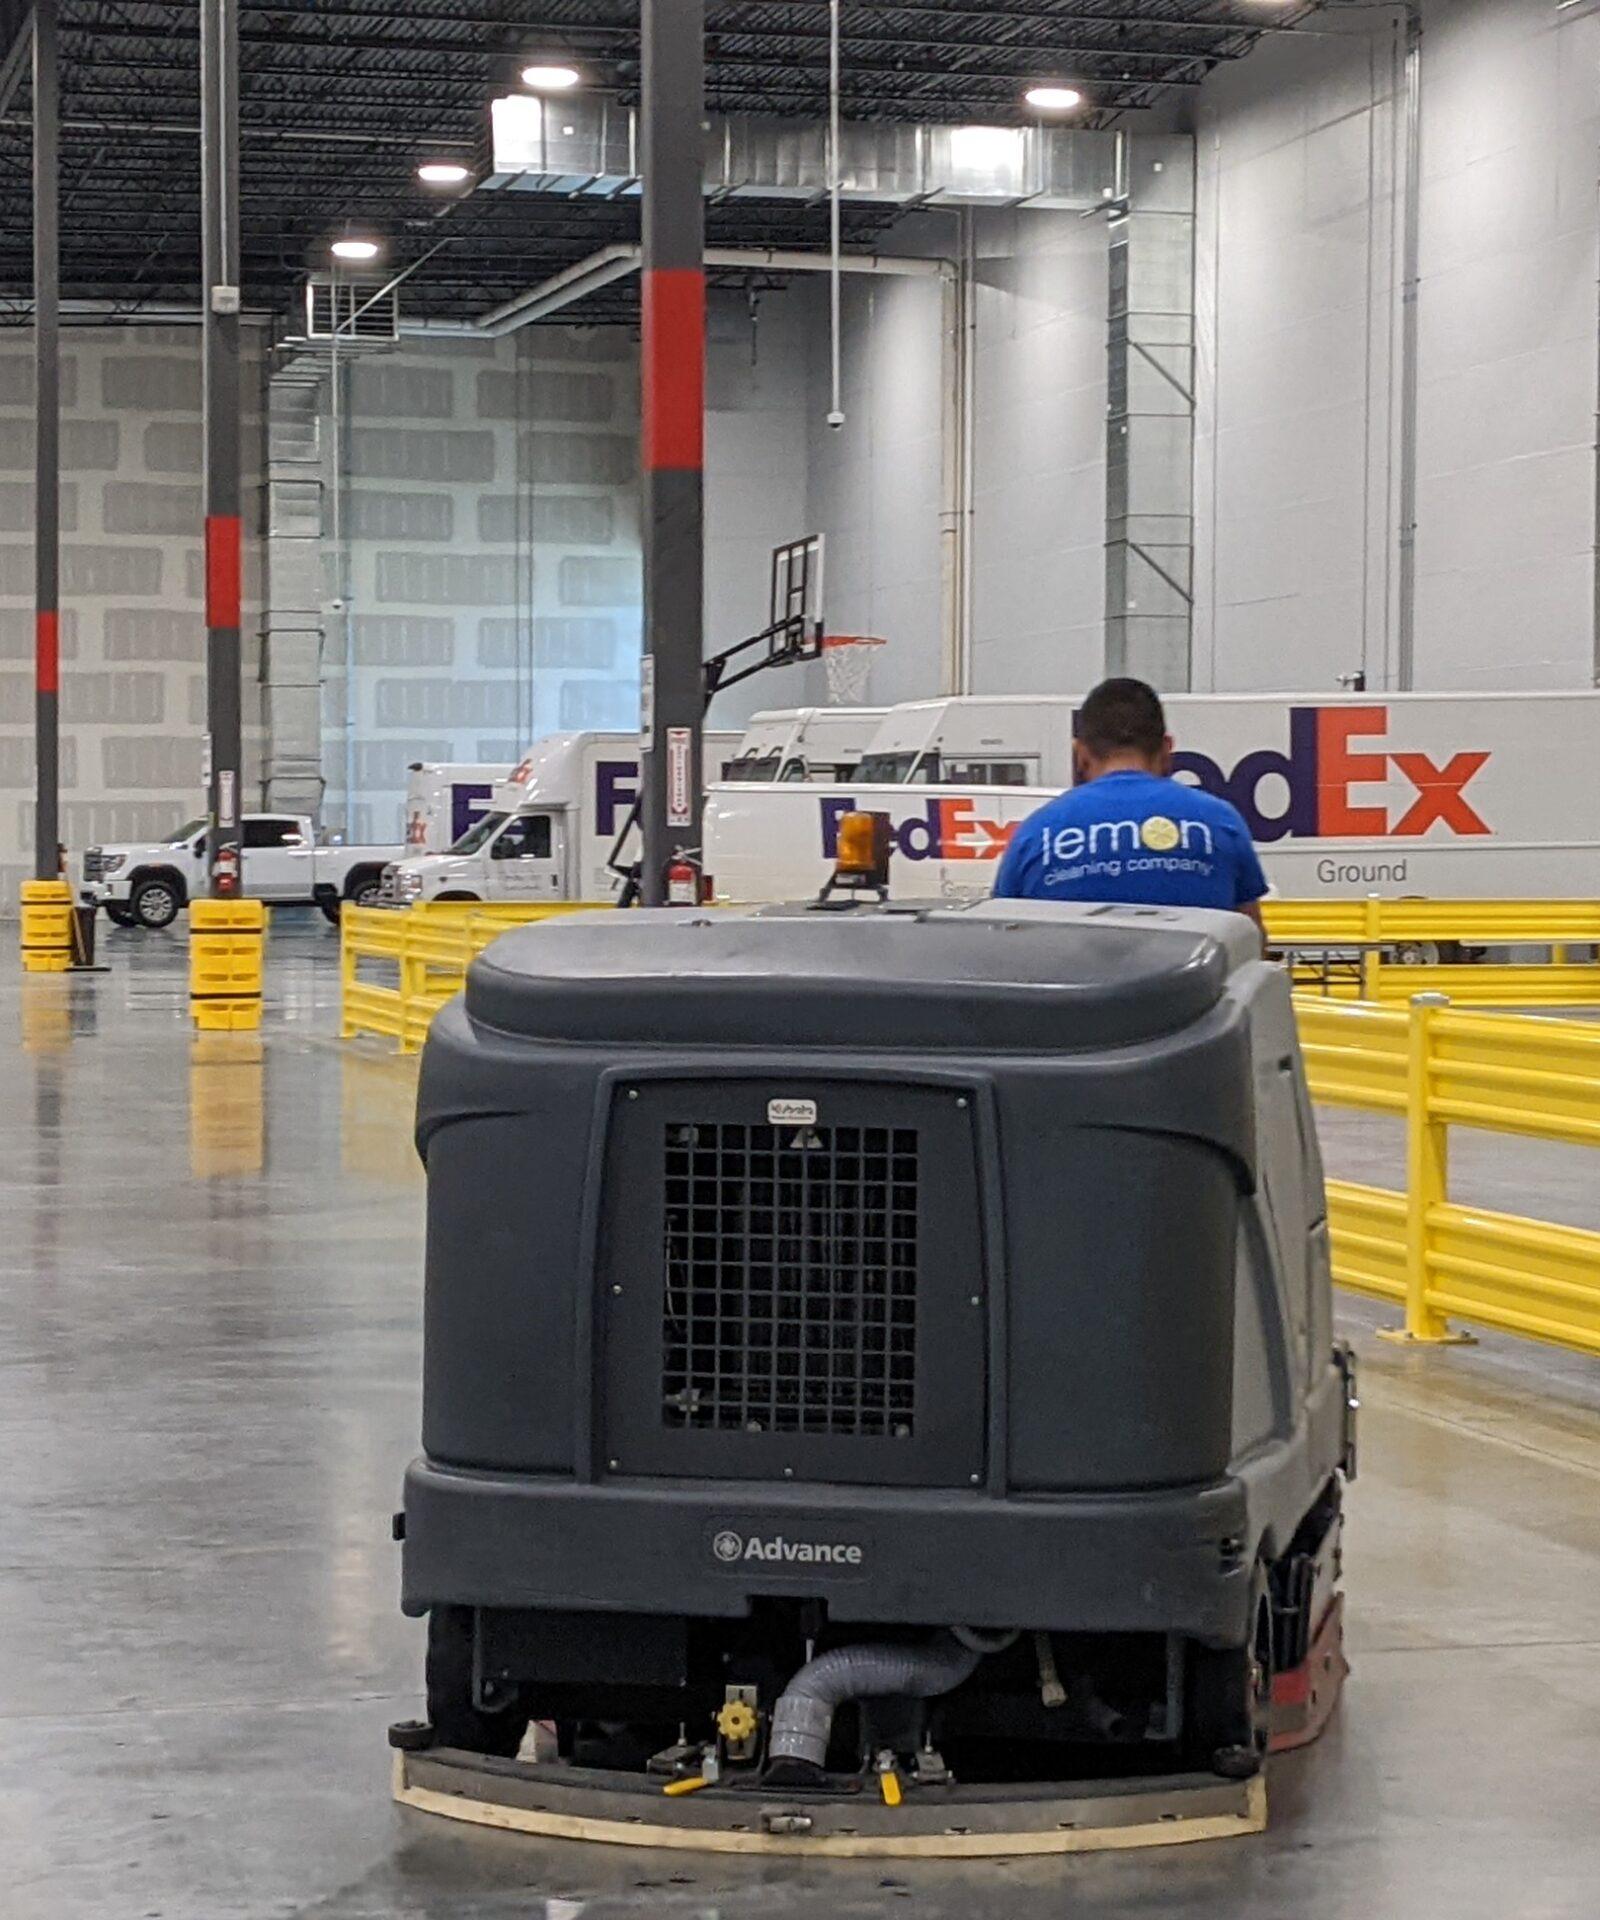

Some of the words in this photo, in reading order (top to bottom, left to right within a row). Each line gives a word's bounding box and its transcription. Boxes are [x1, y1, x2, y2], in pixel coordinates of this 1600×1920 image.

[1042, 816, 1212, 866] lemon
[1043, 860, 1121, 886] cleaning
[1127, 857, 1213, 877] company
[1317, 860, 1407, 883] Ground
[744, 1536, 862, 1564] Advance
